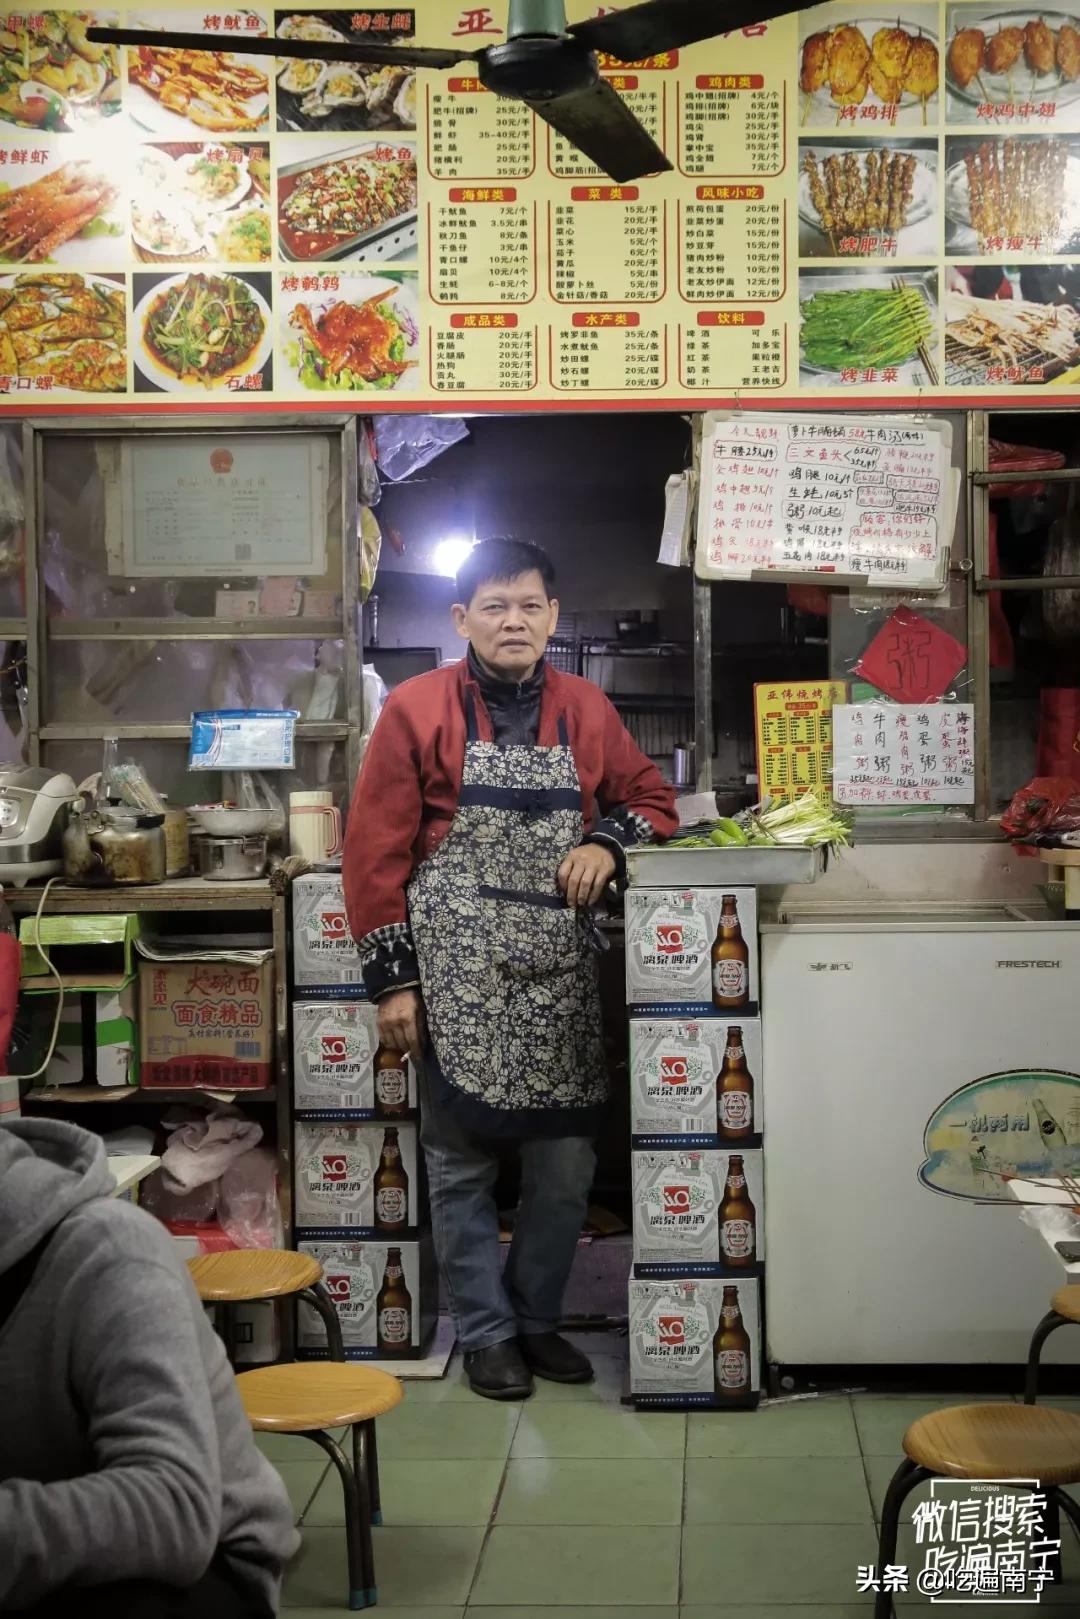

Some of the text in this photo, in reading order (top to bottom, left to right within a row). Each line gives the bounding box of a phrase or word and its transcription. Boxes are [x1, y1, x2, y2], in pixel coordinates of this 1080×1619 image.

[204, 14, 261, 31] 烤鱿鱼
[709, 77, 751, 89] 鸡肉类
[496, 106, 530, 114] 25元/手
[839, 104, 898, 121] 烤鸡排
[976, 103, 1057, 119] 烤鸡中翅
[745, 112, 779, 120] 30元/手
[496, 118, 530, 126] 30元/手
[745, 122, 779, 130] 25元/手
[478, 131, 530, 139] 35-40元/手
[496, 143, 530, 151] 25元/手
[745, 143, 779, 151] 35元/手
[206, 148, 263, 164] 烤扇贝
[375, 147, 412, 162] 烤鱼
[496, 155, 530, 163] 20元/手
[752, 153, 779, 161] 7元/个
[497, 167, 530, 176] 35元/手
[463, 189, 504, 201] 海鲜类
[588, 188, 623, 200] 菜类
[703, 187, 759, 199] 风味小吃
[500, 207, 528, 215] 7元/个
[490, 219, 528, 227] 3.5元/串
[624, 216, 658, 224] 20元/手
[746, 217, 779, 225] 20元/份
[439, 231, 528, 240] 秋刀鱼 8元/条
[624, 227, 658, 235] 20元/手
[630, 238, 658, 246] 5元/个
[747, 241, 779, 249] 15元/份
[839, 237, 897, 252] 烤肥牛
[985, 237, 1043, 252] 烤瘦牛
[439, 243, 528, 252] 干鱼仔 3元/串
[556, 248, 658, 257] 茄子 6元/个
[747, 253, 779, 261] 10元/份
[439, 255, 528, 264] 青口螺 10元/4个
[624, 259, 658, 267] 20元/手
[686, 266, 724, 274] 老友炒粉
[280, 275, 340, 292] 烤鹌鹑
[488, 280, 528, 288] 6-8元/个
[747, 278, 780, 286] 12元/份
[500, 292, 528, 300] 8元/个
[625, 291, 658, 299] 20元/手
[747, 290, 780, 298] 12元/份
[464, 314, 505, 326] 成品类
[586, 314, 627, 326] 水产类
[718, 312, 745, 324] 饮料
[437, 331, 532, 340] 豆腐皮 20元/手
[560, 330, 659, 339] 烤罗非鱼 35元/条
[686, 329, 780, 338] 啤酒 可乐
[437, 341, 532, 350] 香肠 20元/手
[561, 343, 659, 351] 水煮鱿鱼 25元/条
[686, 341, 780, 350] 绿茶 加多宝
[437, 351, 532, 360] 火腿肠 20元/手
[560, 355, 589, 363] 炒田螺
[686, 353, 780, 362] 红茶 果粒橙
[437, 361, 532, 370] 热狗 20元/手
[686, 365, 780, 374] 奶茶 王老吉
[499, 371, 532, 379] 30元/手
[560, 367, 589, 375] 炒石螺
[839, 368, 899, 383] 烤韭菜
[985, 367, 1044, 382] 烤鱿鱼
[225, 374, 262, 390] 石螺
[499, 381, 532, 389] 20元/手
[625, 379, 659, 387] 20元/碟
[742, 377, 780, 385] 营养快线
[887, 631, 932, 689] 粥
[873, 712, 891, 774] 牛肉粥
[917, 713, 937, 774] 鸡蛋粥
[643, 954, 699, 965] 漓泉啤酒
[997, 960, 1060, 969] FRESTECH
[184, 966, 260, 996] 大碗面
[175, 1003, 259, 1025] 面食精品
[309, 1063, 361, 1074] 漓泉啤酒
[647, 1085, 703, 1096] 漓泉啤酒
[309, 1181, 362, 1192] 漓泉啤酒
[650, 1214, 705, 1226] 漓泉啤酒
[645, 1345, 701, 1356] 漓泉啤酒
